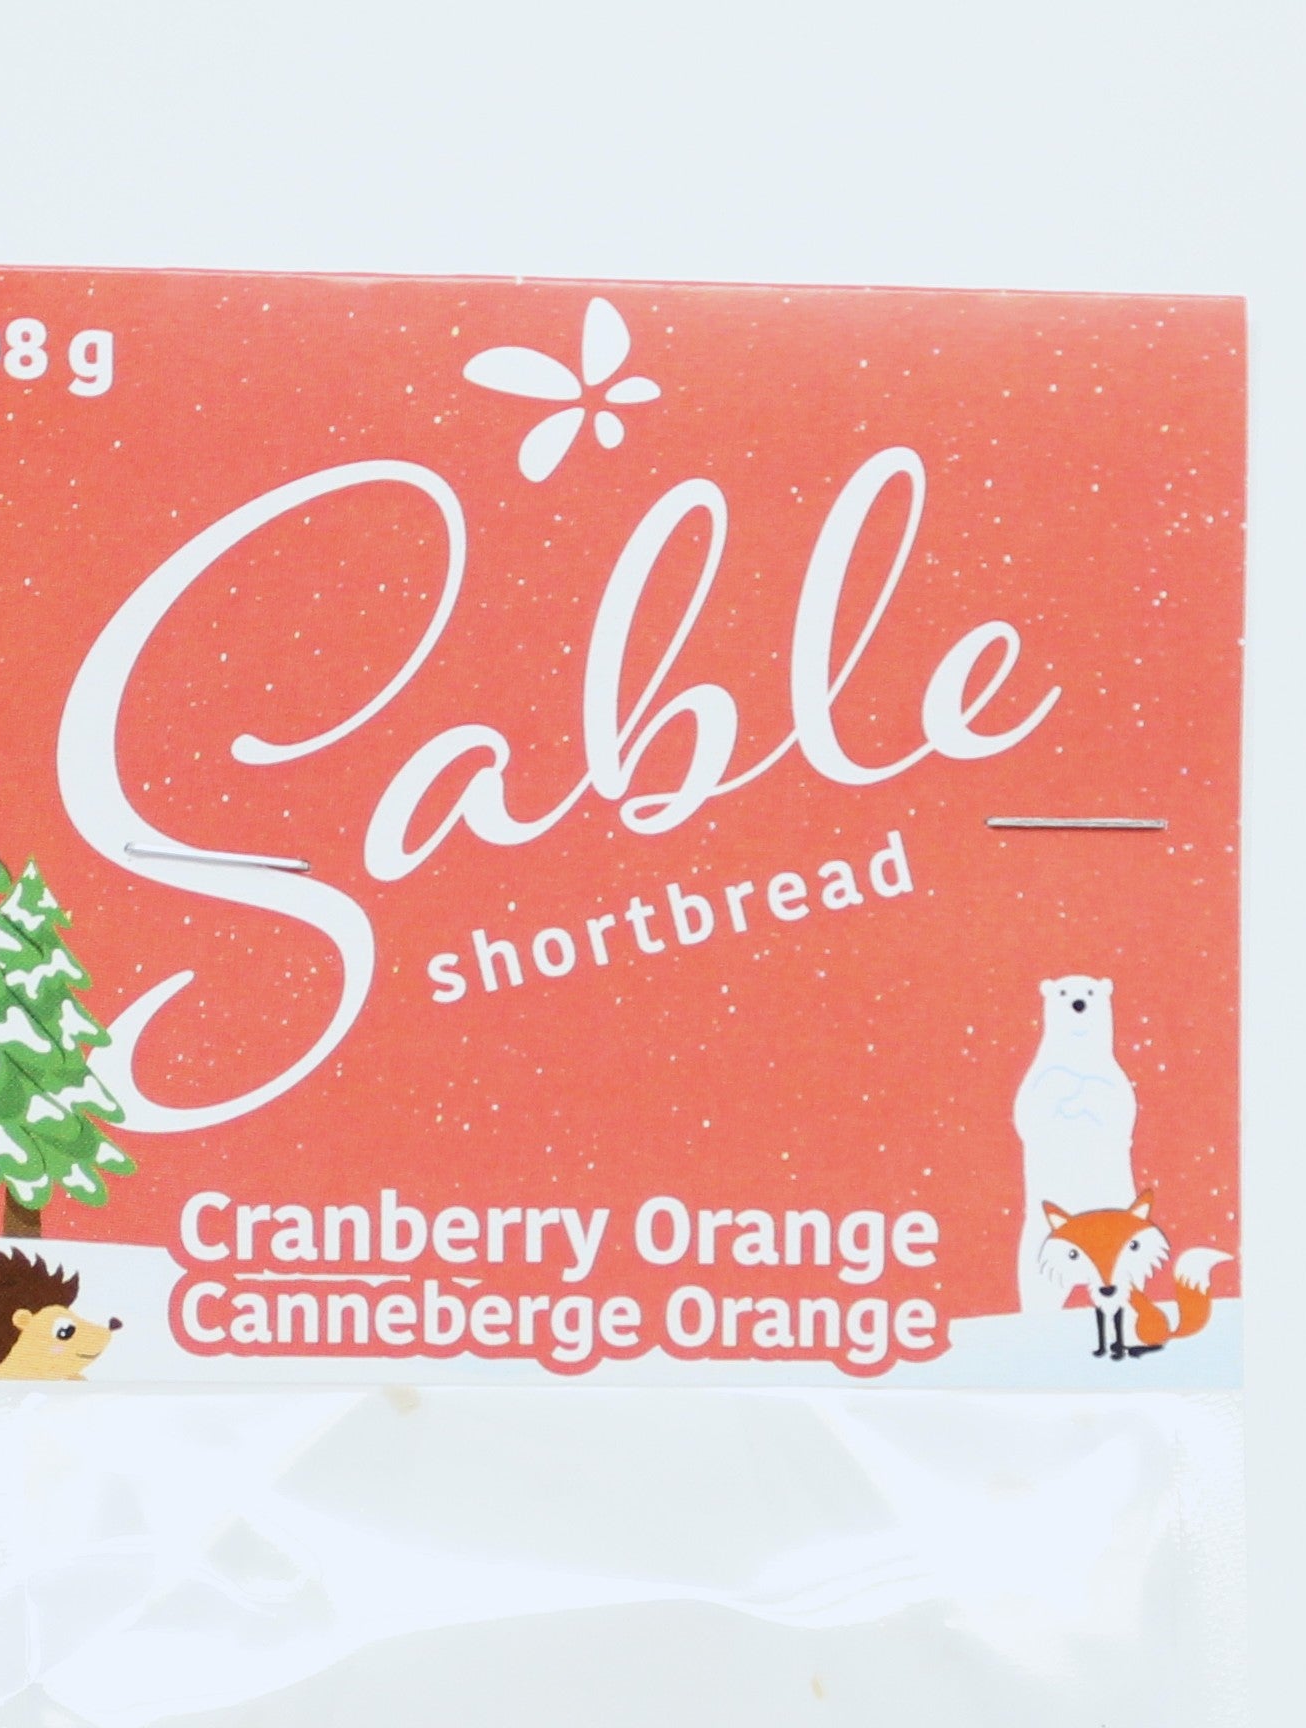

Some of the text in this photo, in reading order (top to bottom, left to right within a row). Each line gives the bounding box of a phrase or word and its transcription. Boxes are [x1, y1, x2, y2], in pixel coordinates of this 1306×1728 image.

[66, 330, 116, 398] g
[56, 445, 1063, 1133] Sable
[425, 831, 915, 1004] shortbread
[178, 1189, 940, 1285] Cranberry Orange
[179, 1281, 938, 1366] Canneberge Orange
